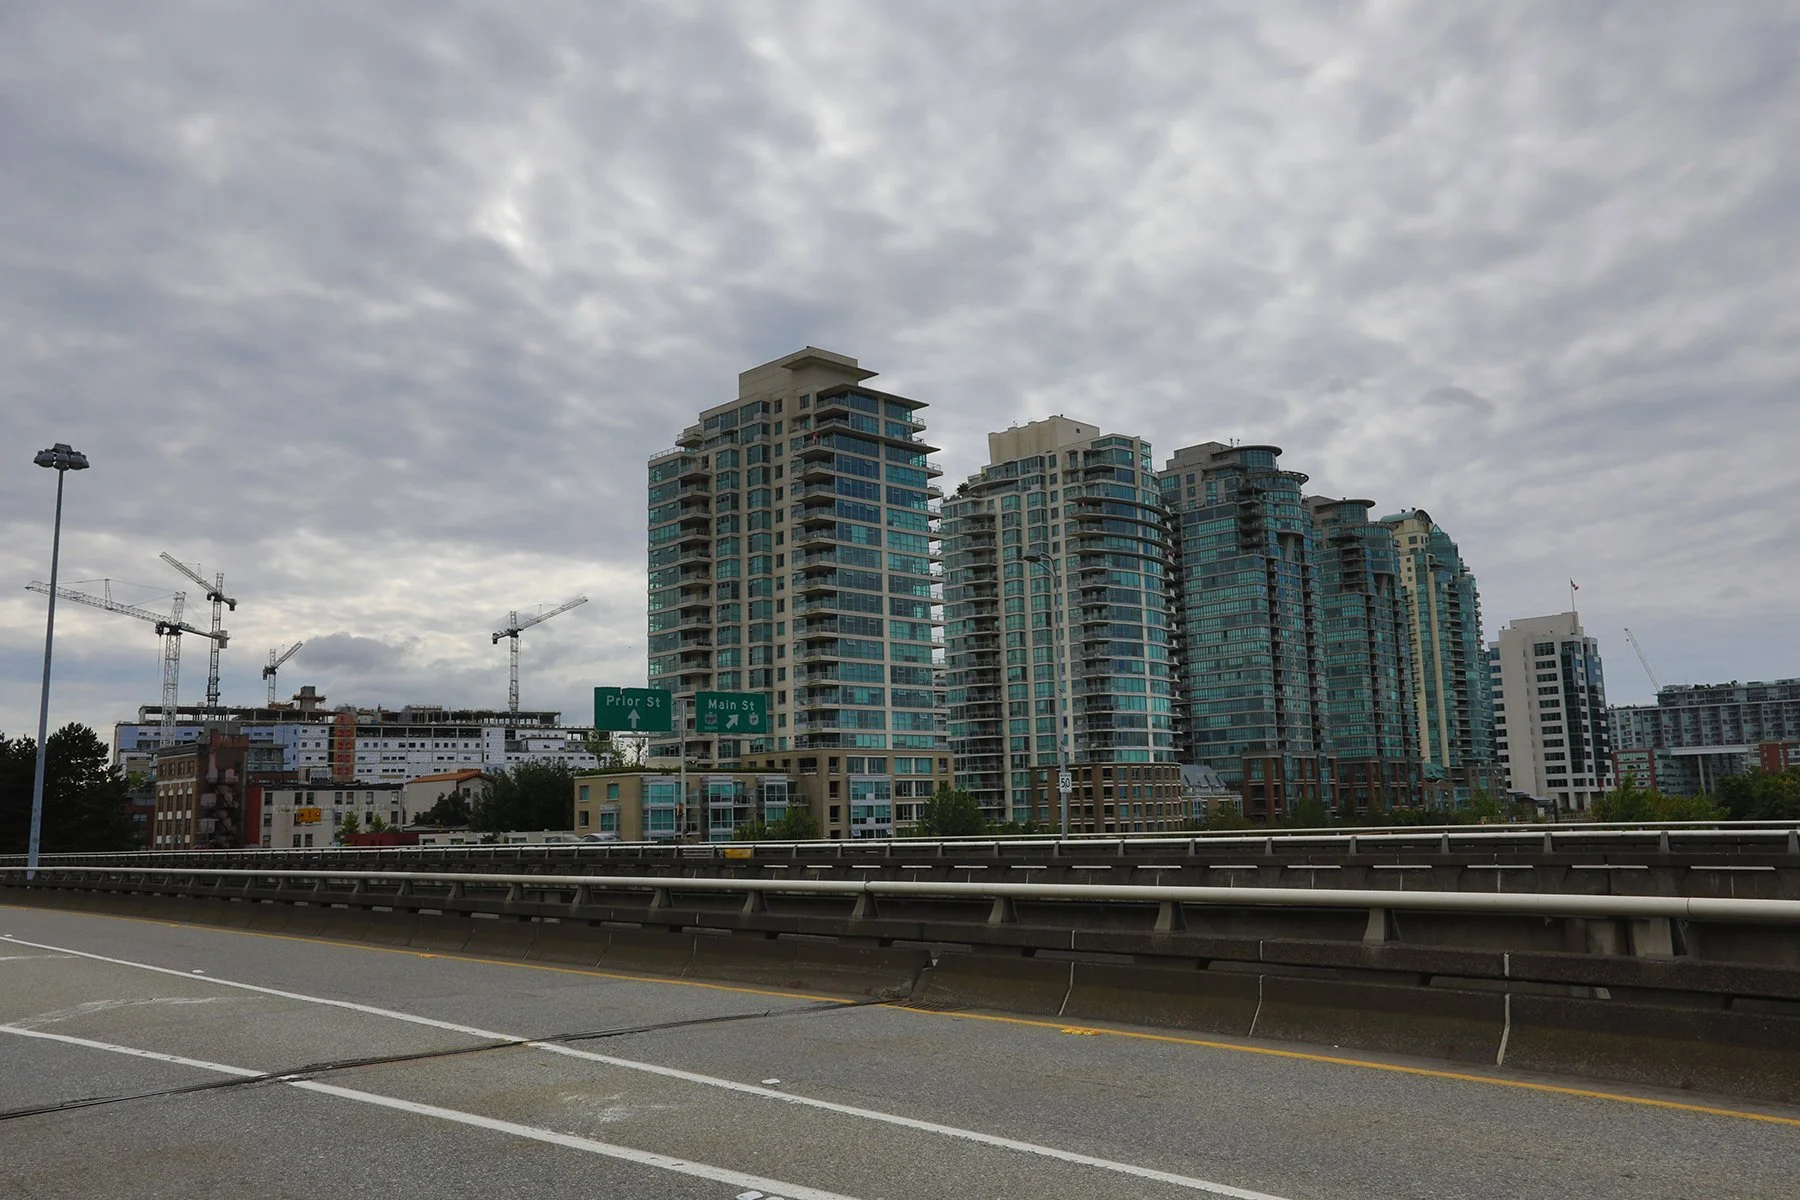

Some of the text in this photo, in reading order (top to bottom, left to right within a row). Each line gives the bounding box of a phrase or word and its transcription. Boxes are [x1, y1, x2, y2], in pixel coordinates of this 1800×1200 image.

[606, 695, 661, 707] Prior St
[708, 699, 755, 711] Main St
[1061, 778, 1070, 788] 50
